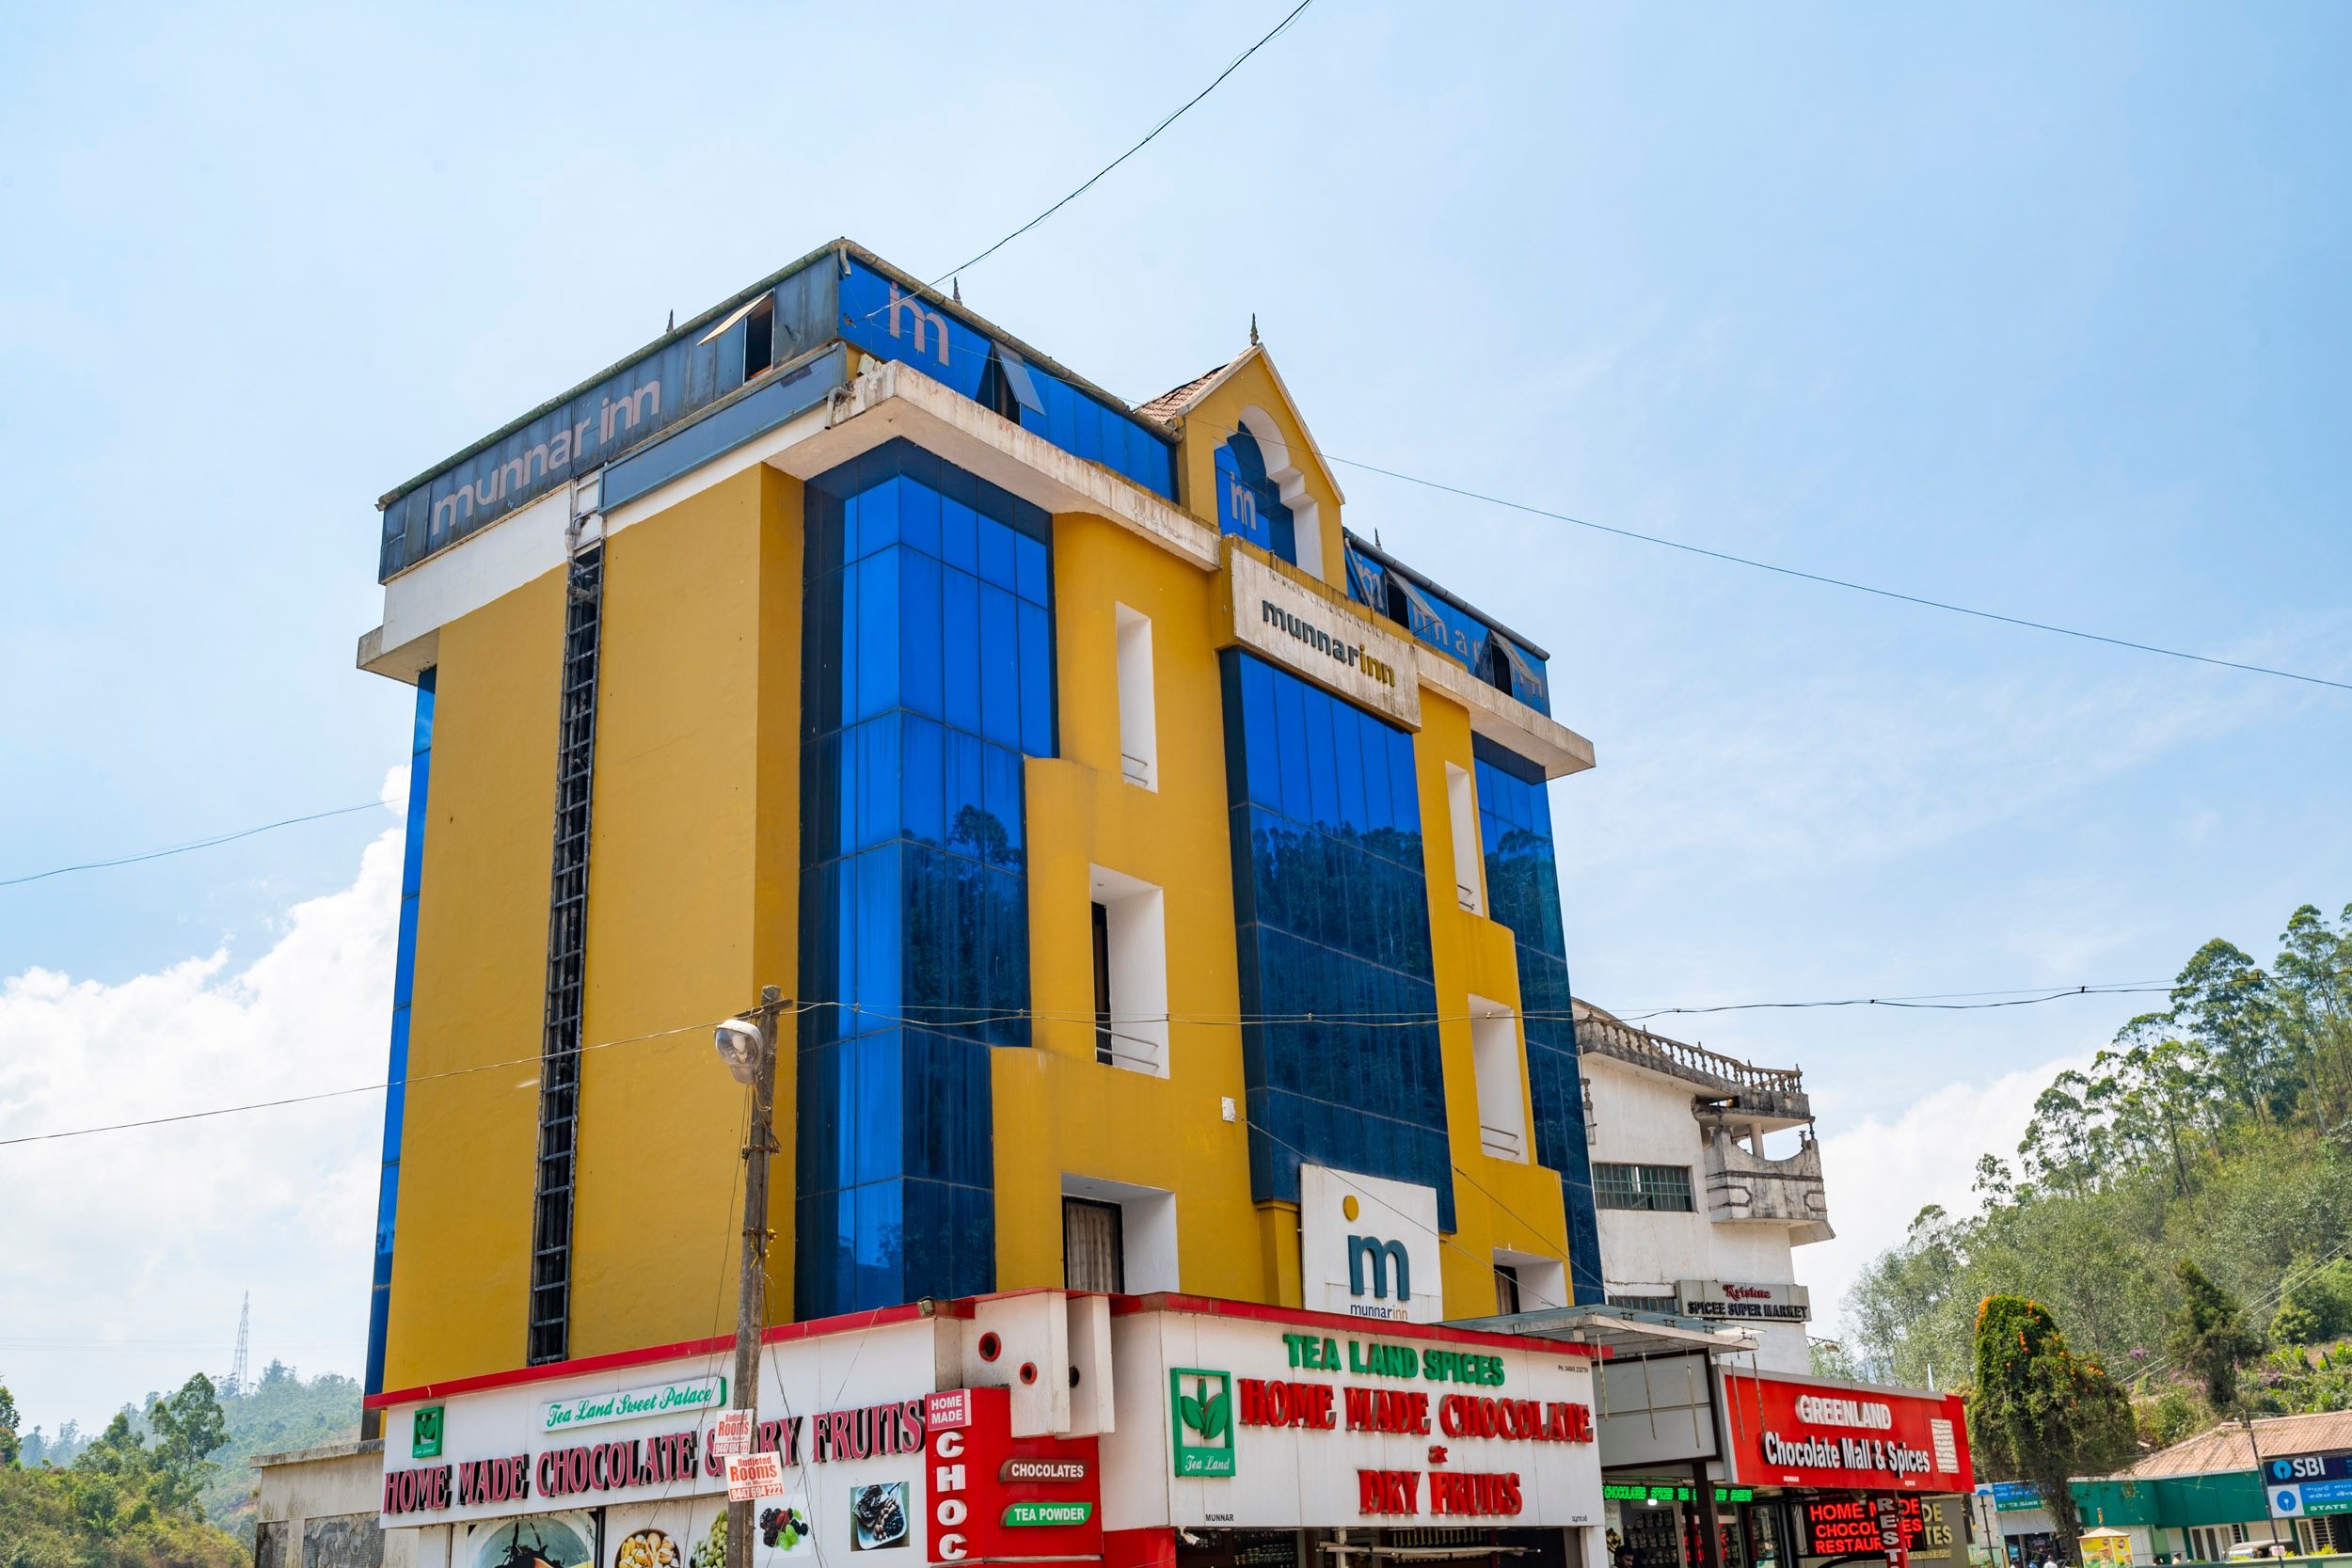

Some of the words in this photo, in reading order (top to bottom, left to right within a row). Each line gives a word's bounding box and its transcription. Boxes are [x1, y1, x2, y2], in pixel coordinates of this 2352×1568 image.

[433, 416, 591, 536] munnar
[599, 380, 660, 446] inn
[1727, 1303, 1762, 1317] SUPER
[1764, 1305, 1808, 1319] MARKET
[1282, 1333, 1343, 1371] TEA
[1348, 1340, 1419, 1378] LAND
[1423, 1349, 1505, 1386] SPICES
[547, 1404, 571, 1428] Tea
[575, 1397, 614, 1421] Land
[616, 1394, 658, 1415] Sweet
[660, 1386, 712, 1410] Palace
[930, 1395, 962, 1411] HOME
[1238, 1378, 1336, 1430] HOME
[1343, 1386, 1431, 1435] MADE
[1439, 1393, 1594, 1443] CHOCOLATE
[1795, 1394, 1892, 1430] GREENLAND
[931, 1409, 962, 1424] MADE
[382, 1465, 451, 1513] HOME
[458, 1454, 529, 1505] MADE
[536, 1431, 697, 1497] CHOCOLATE
[705, 1428, 725, 1477] &
[755, 1417, 802, 1466] RY
[812, 1400, 923, 1464] FRUITS
[738, 1456, 771, 1467] Budjeted
[1184, 1454, 1202, 1471] Tea
[1204, 1454, 1231, 1470] Land
[1427, 1445, 1449, 1465] &
[1762, 1431, 1840, 1469] Chocolate
[1840, 1437, 1872, 1469] Mall
[1872, 1439, 1886, 1470] &
[1886, 1440, 1931, 1479] Spices
[1011, 1464, 1084, 1478] CHOCOLATES
[2293, 1457, 2326, 1478] SBI
[731, 1487, 749, 1499] 9447
[751, 1485, 767, 1497] 694
[767, 1484, 782, 1496] 222
[1358, 1468, 1422, 1515] DRY
[1429, 1472, 1522, 1516] FRUITS
[1014, 1508, 1037, 1521] TEA
[1040, 1507, 1085, 1521] POWDER
[1205, 1513, 1234, 1522] MUNNAR
[1809, 1502, 1866, 1522] HOME
[2310, 1503, 2348, 1512] STATE
[1876, 1497, 1902, 1568] REST
